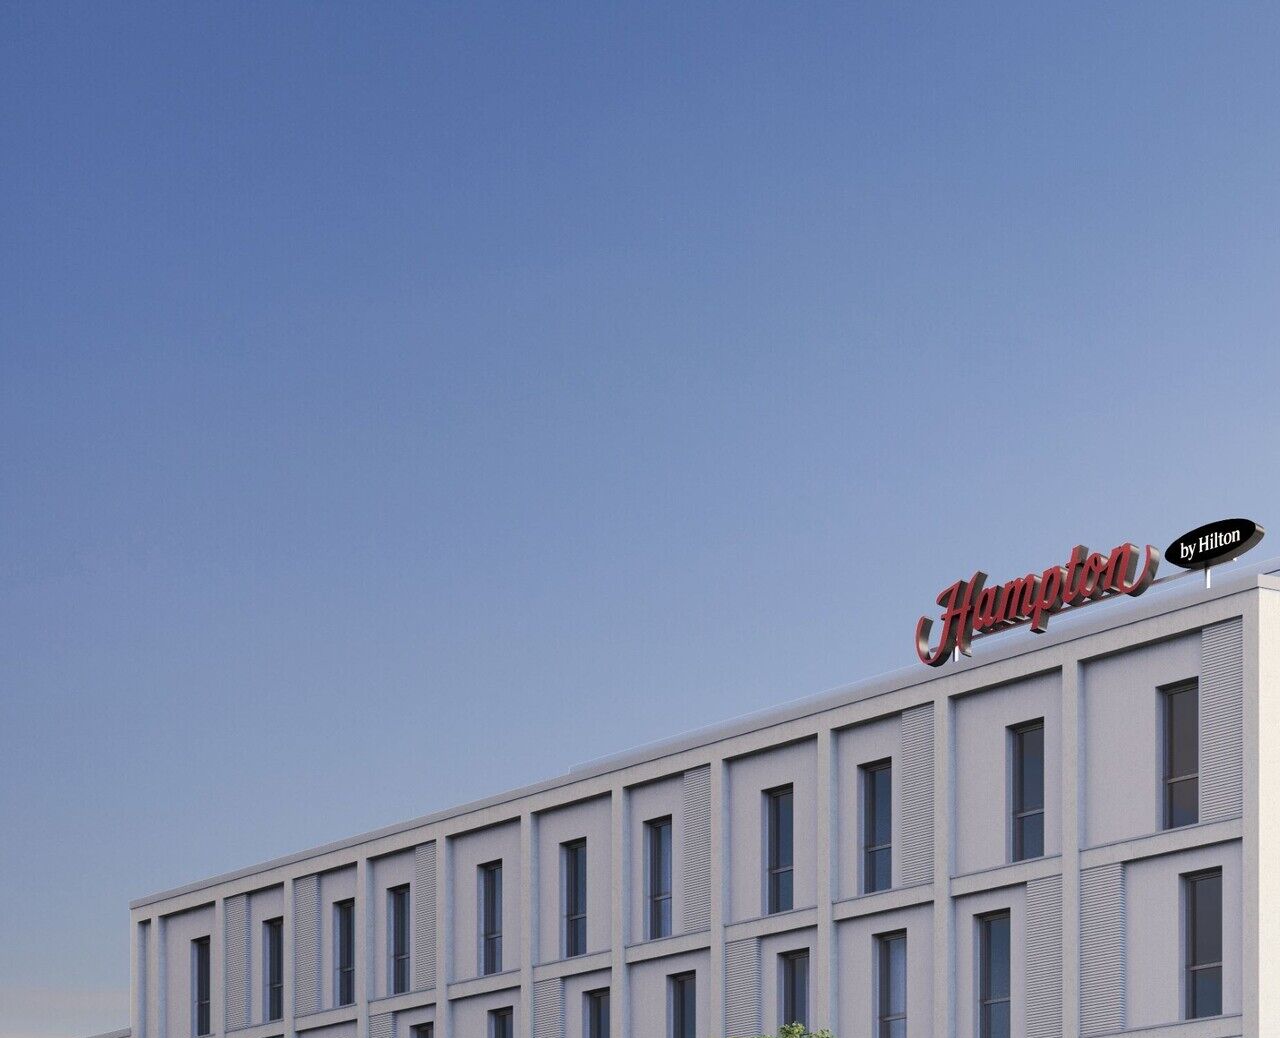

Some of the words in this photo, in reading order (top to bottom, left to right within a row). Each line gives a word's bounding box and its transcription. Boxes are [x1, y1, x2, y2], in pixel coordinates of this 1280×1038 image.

[1180, 542, 1196, 561] by
[1198, 529, 1241, 553] Hilton
[915, 542, 1160, 667] Hampton
